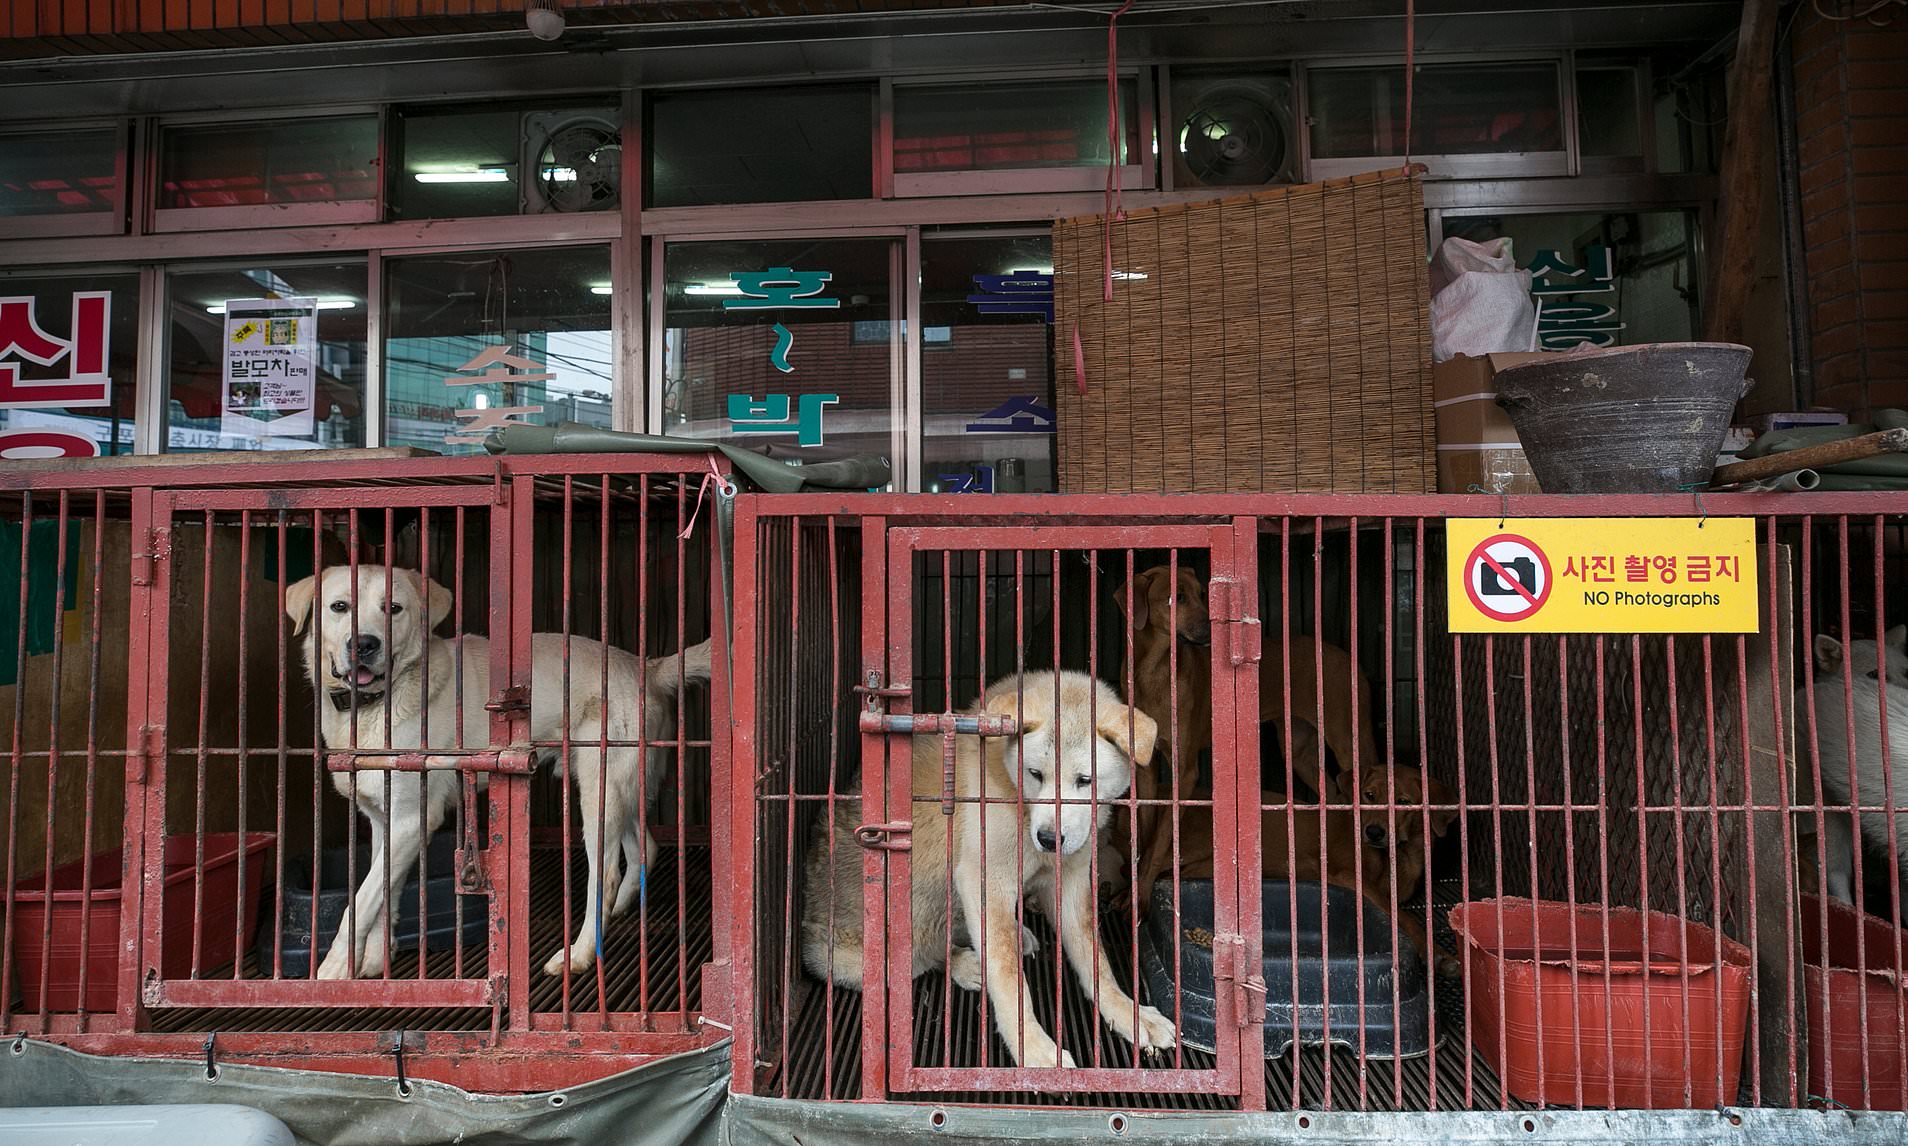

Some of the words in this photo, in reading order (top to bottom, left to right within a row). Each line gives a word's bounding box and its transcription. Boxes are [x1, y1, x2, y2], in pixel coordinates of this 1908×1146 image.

[231, 358, 290, 378] 발모차
[1562, 555, 1616, 583] 사진
[1624, 554, 1677, 584] 촬영
[1686, 555, 1740, 583] 금지
[1584, 591, 1609, 606] NO
[1615, 591, 1720, 608] Photographs
